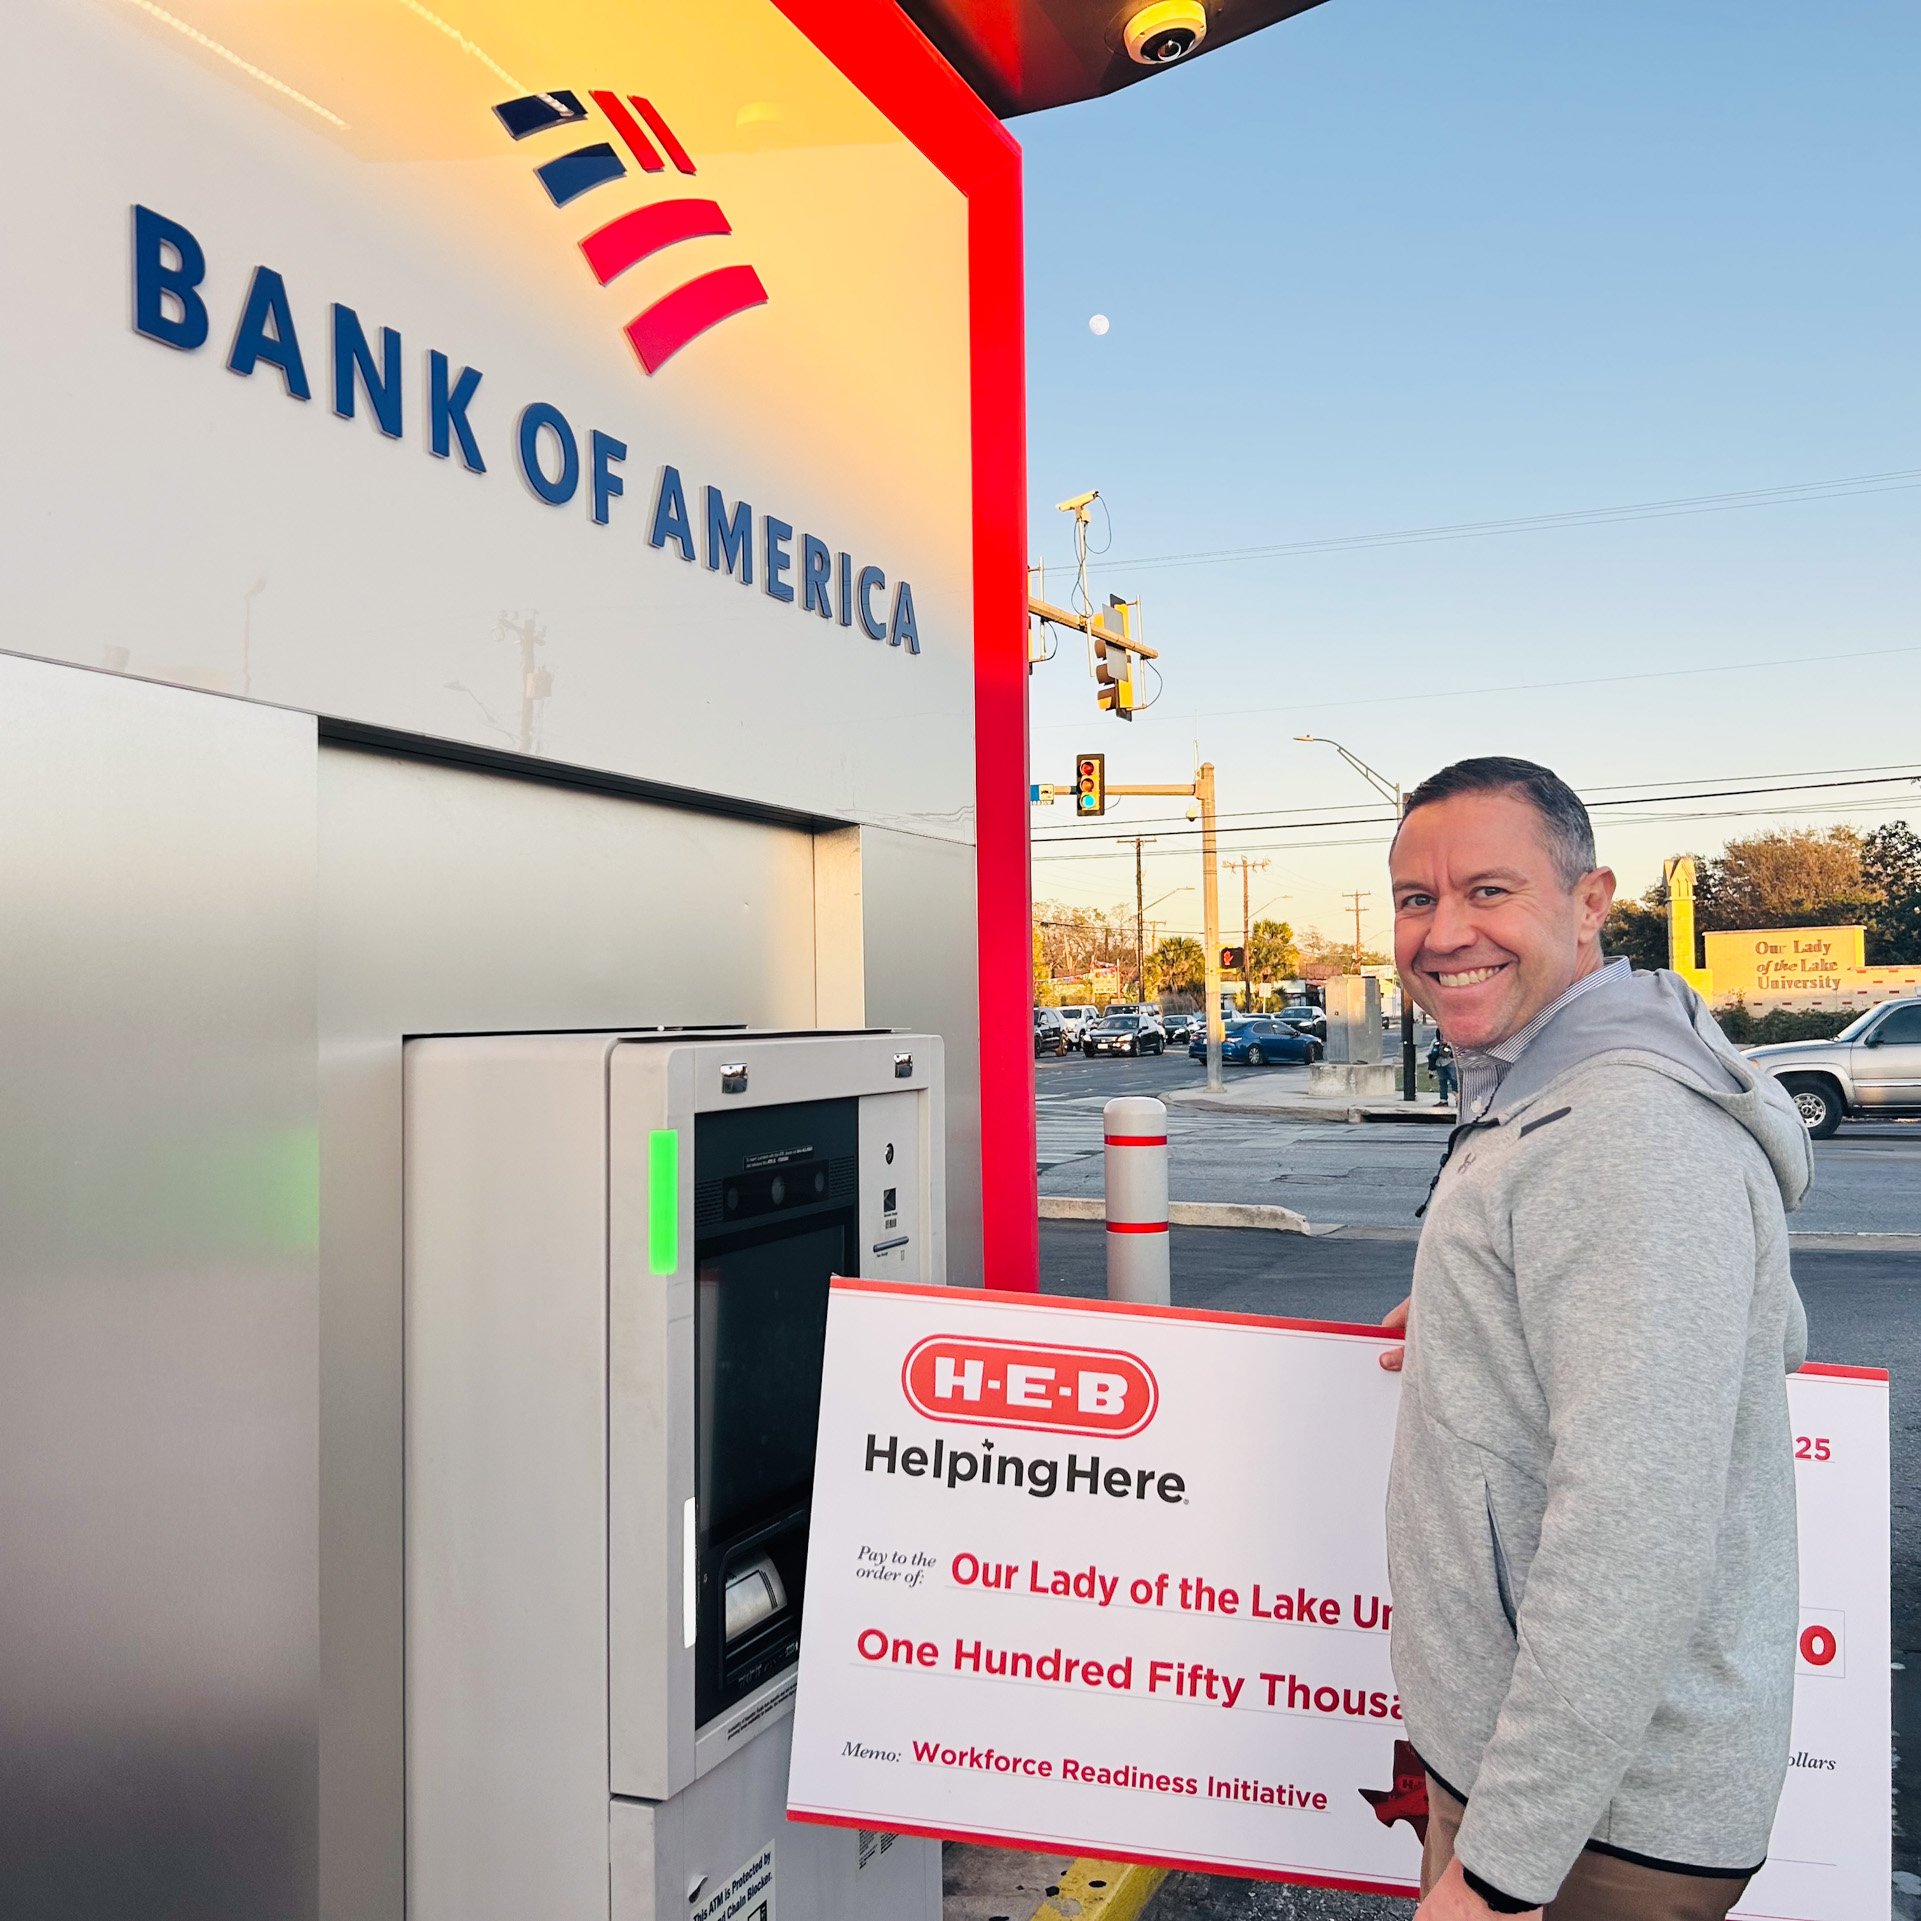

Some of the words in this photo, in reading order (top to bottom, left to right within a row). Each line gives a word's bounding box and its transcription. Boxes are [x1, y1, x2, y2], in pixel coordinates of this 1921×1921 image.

[133, 203, 487, 474] BANK
[518, 402, 627, 525] OF
[649, 465, 921, 654] AMERICA
[1755, 941, 1788, 955] Our
[1794, 939, 1832, 956] Lady
[1756, 960, 1774, 975] of
[1774, 960, 1797, 972] the
[1801, 958, 1838, 972] Lake
[1757, 976, 1841, 991] University
[934, 1356, 1128, 1415] H-E-B
[855, 1565, 902, 1581] order
[904, 1570, 924, 1588] of:
[857, 1545, 888, 1565] Pay
[891, 1551, 908, 1564] to
[911, 1551, 937, 1568] the
[951, 1551, 1019, 1591] Our
[1029, 1560, 1120, 1609] Lady
[1129, 1572, 1170, 1607] of
[1178, 1576, 1240, 1615] the
[1251, 1583, 1341, 1626] Lake
[856, 1628, 940, 1668] One
[954, 1638, 1133, 1691] Hundred
[1148, 1660, 1246, 1709] Fifty
[841, 1741, 901, 1763] Memo:
[912, 1740, 1053, 1778] Workforce
[1062, 1758, 1198, 1796] Readiness
[1207, 1775, 1327, 1810] Initiative
[1788, 1751, 1837, 1771] ollars
[709, 1891, 723, 1916] ATM
[725, 1888, 730, 1901] is
[732, 1855, 763, 1895] Protected
[764, 1851, 771, 1865] by
[727, 1894, 746, 1919] Chain
[747, 1871, 773, 1901] Blocker.
